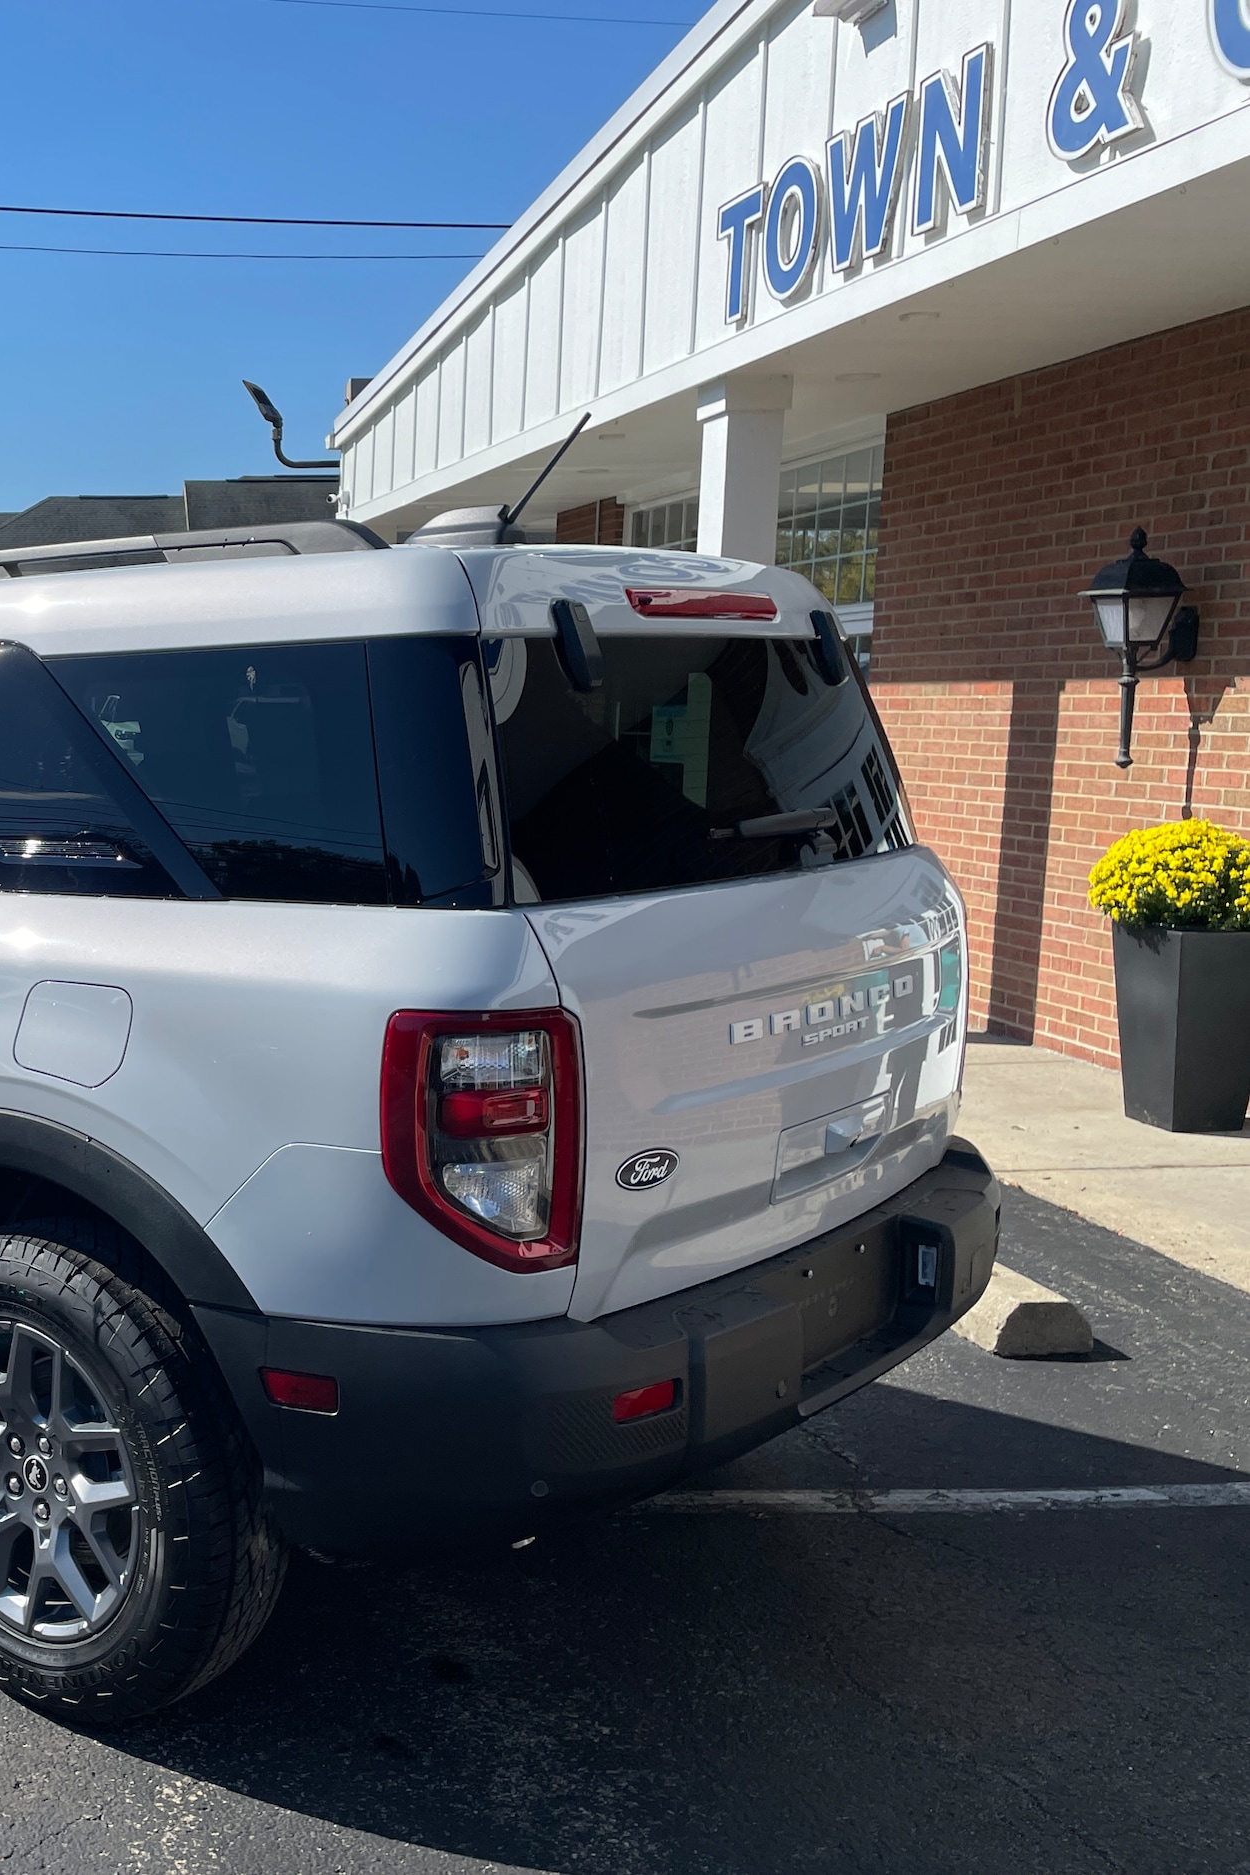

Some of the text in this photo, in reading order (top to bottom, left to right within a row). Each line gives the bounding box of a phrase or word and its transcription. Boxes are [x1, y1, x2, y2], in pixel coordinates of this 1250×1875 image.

[717, 0, 1144, 325] TOWN &
[730, 975, 913, 1045] BRONCO
[801, 1015, 870, 1047] SPORT
[626, 1154, 671, 1187] Ford
